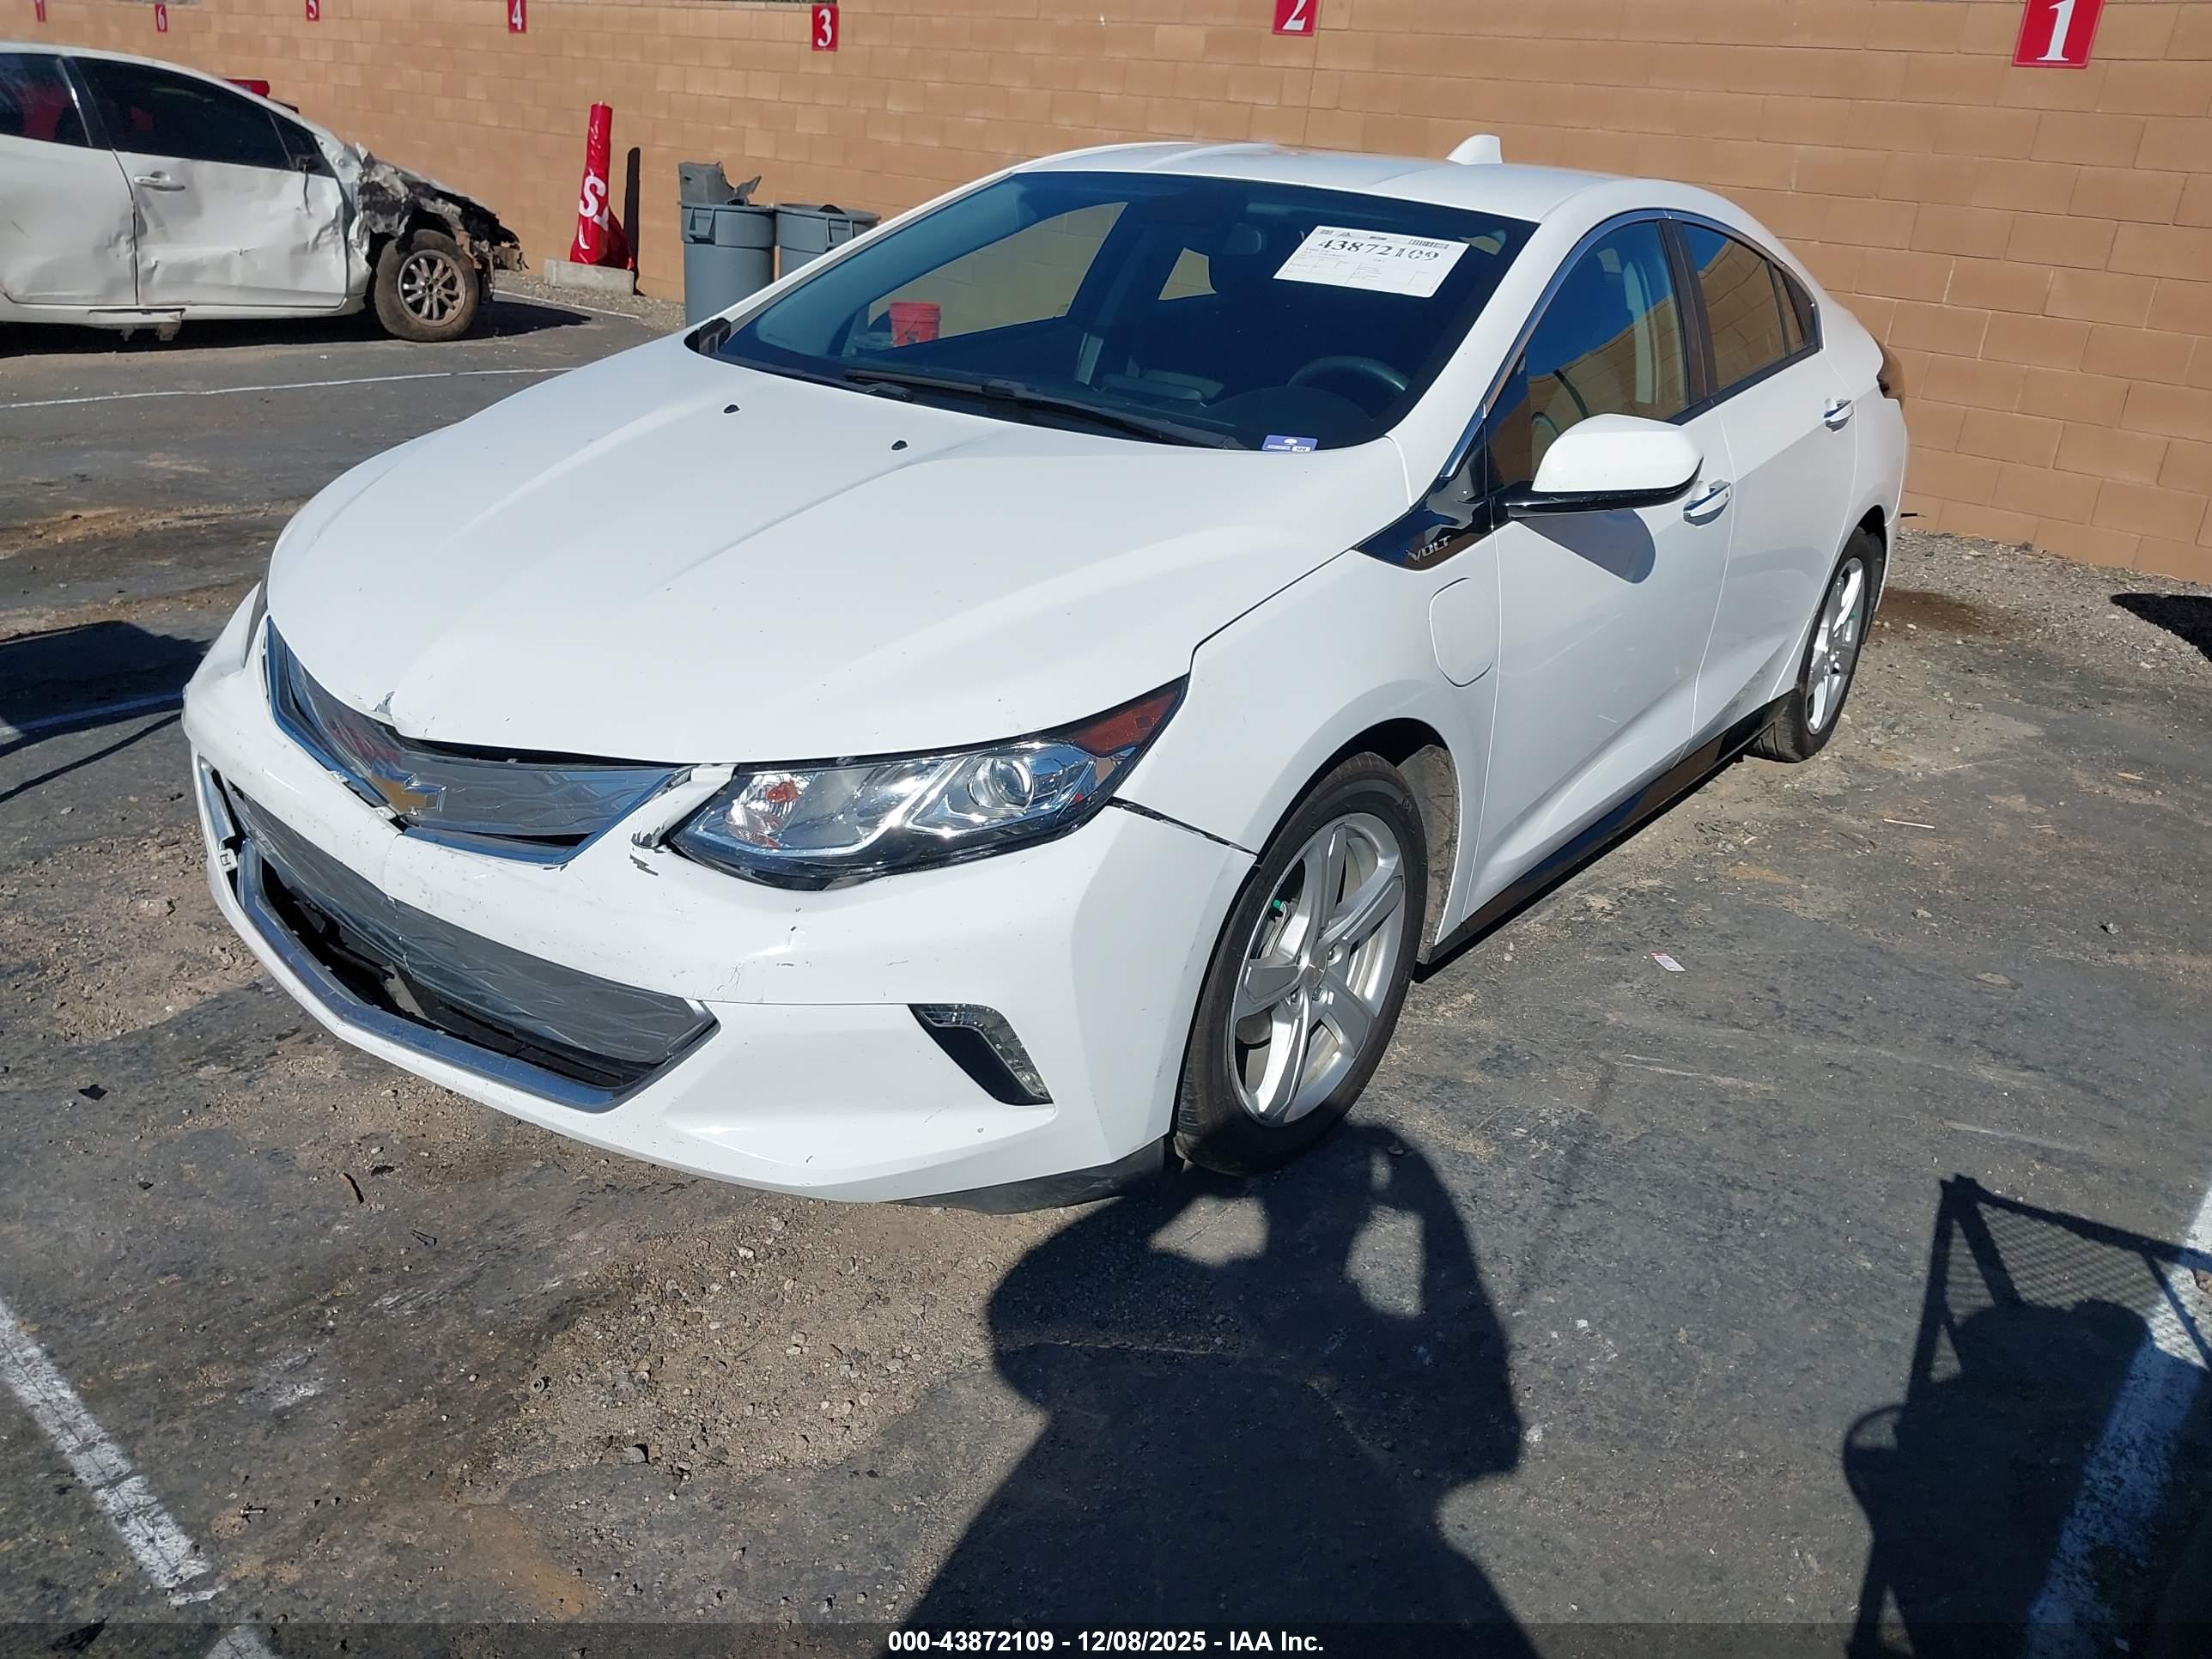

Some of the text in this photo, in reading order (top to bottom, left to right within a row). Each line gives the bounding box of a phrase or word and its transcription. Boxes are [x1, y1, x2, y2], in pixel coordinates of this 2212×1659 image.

[157, 6, 165, 30] 6
[511, 0, 522, 30] 4
[817, 8, 832, 46] 3
[1282, 0, 1306, 31] 2
[2036, 0, 2075, 61] 1
[1318, 239, 1440, 261] 43872109
[1405, 535, 1451, 562] VOLT
